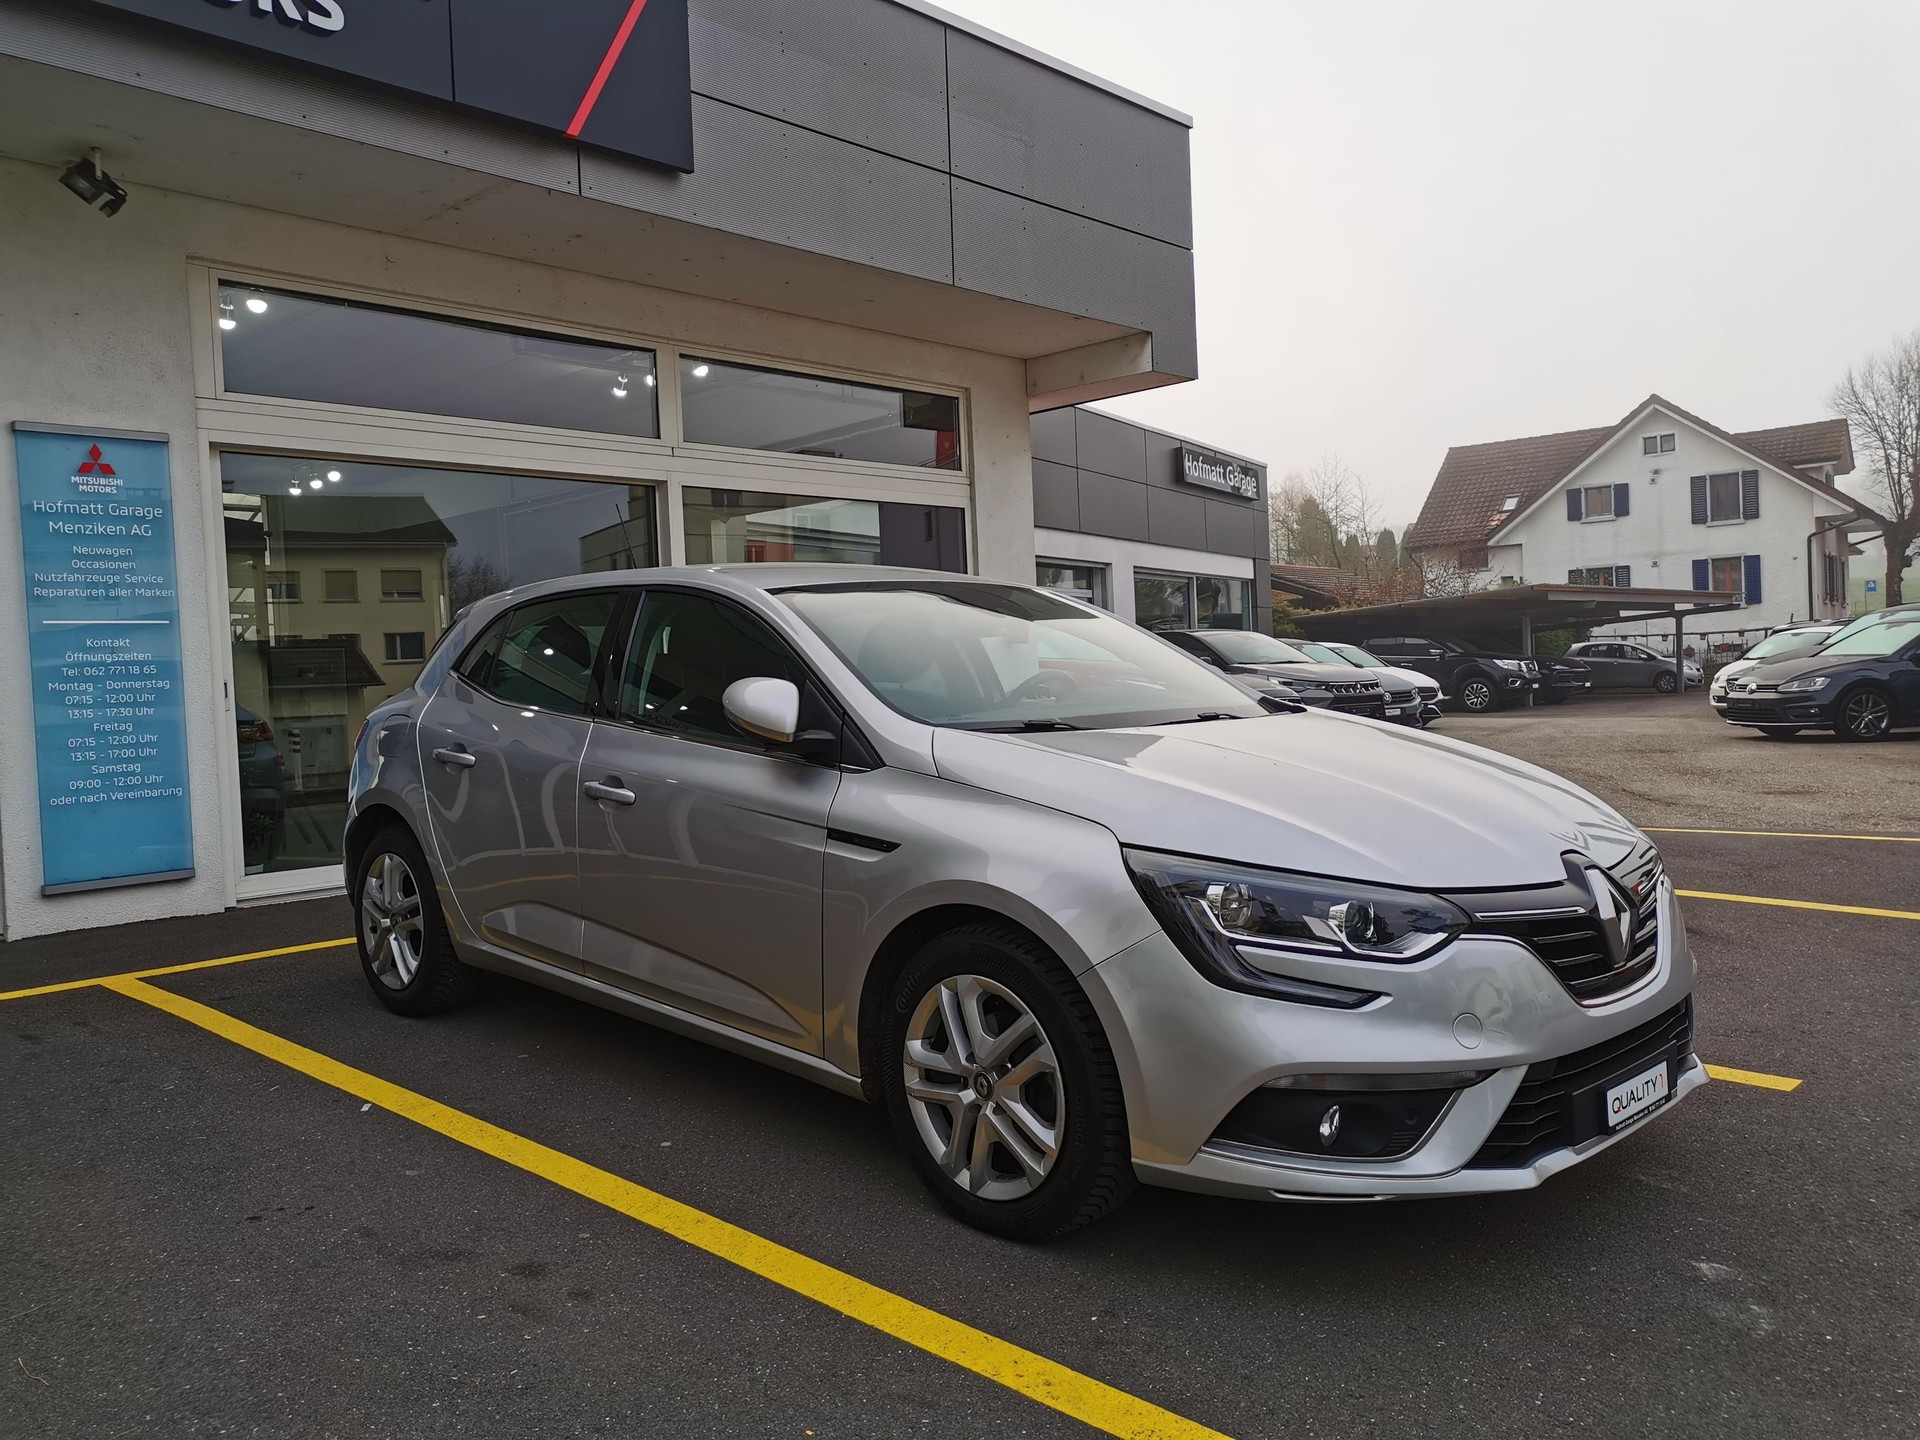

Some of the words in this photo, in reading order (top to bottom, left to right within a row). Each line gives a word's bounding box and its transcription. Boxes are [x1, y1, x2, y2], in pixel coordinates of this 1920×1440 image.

[1185, 453, 1225, 483] Hofmatt
[1226, 466, 1257, 495] Garage
[71, 476, 123, 486] MITSUBISHI
[79, 484, 117, 494] MOTORS
[33, 500, 103, 515] Hofmatt
[109, 503, 163, 520] Garage
[49, 521, 125, 535] Menziken
[131, 524, 152, 536] AG
[73, 545, 133, 557] Neuwagen
[72, 560, 136, 569] Occasionen
[35, 573, 120, 584] Nutzfahrzeuge
[125, 574, 164, 583] Service
[34, 587, 105, 598] Reparaturen
[109, 587, 131, 597] aller
[135, 588, 174, 597] Marken
[86, 638, 130, 648] Kontakt
[65, 651, 152, 662] Öffnungszeiten
[61, 667, 81, 677] Tel:
[84, 666, 105, 676] 062
[108, 666, 126, 675] 771
[128, 666, 140, 674] 18
[143, 665, 157, 674] 65
[48, 681, 94, 692] Montag
[106, 679, 170, 690] Donnerstag
[65, 695, 93, 705] 07:15
[105, 694, 133, 703] 12:00
[136, 693, 156, 703] Uhr
[68, 709, 94, 719] 13:15
[105, 707, 133, 717] 17:30
[136, 707, 155, 716] Uhr
[93, 722, 133, 733] Freitag
[68, 737, 96, 748] 07:15
[108, 735, 136, 745] 12:00
[139, 734, 159, 744] Uhr
[70, 751, 96, 762] 13:15
[108, 748, 136, 758] 17:00
[139, 747, 158, 757] Uhr
[91, 763, 141, 774] Samstag
[69, 779, 101, 790] 09:00
[113, 776, 142, 786] 12:00
[144, 774, 163, 784] Uhr
[50, 795, 77, 806] oder
[80, 792, 107, 803] nach
[110, 786, 183, 801] Vereinbarung
